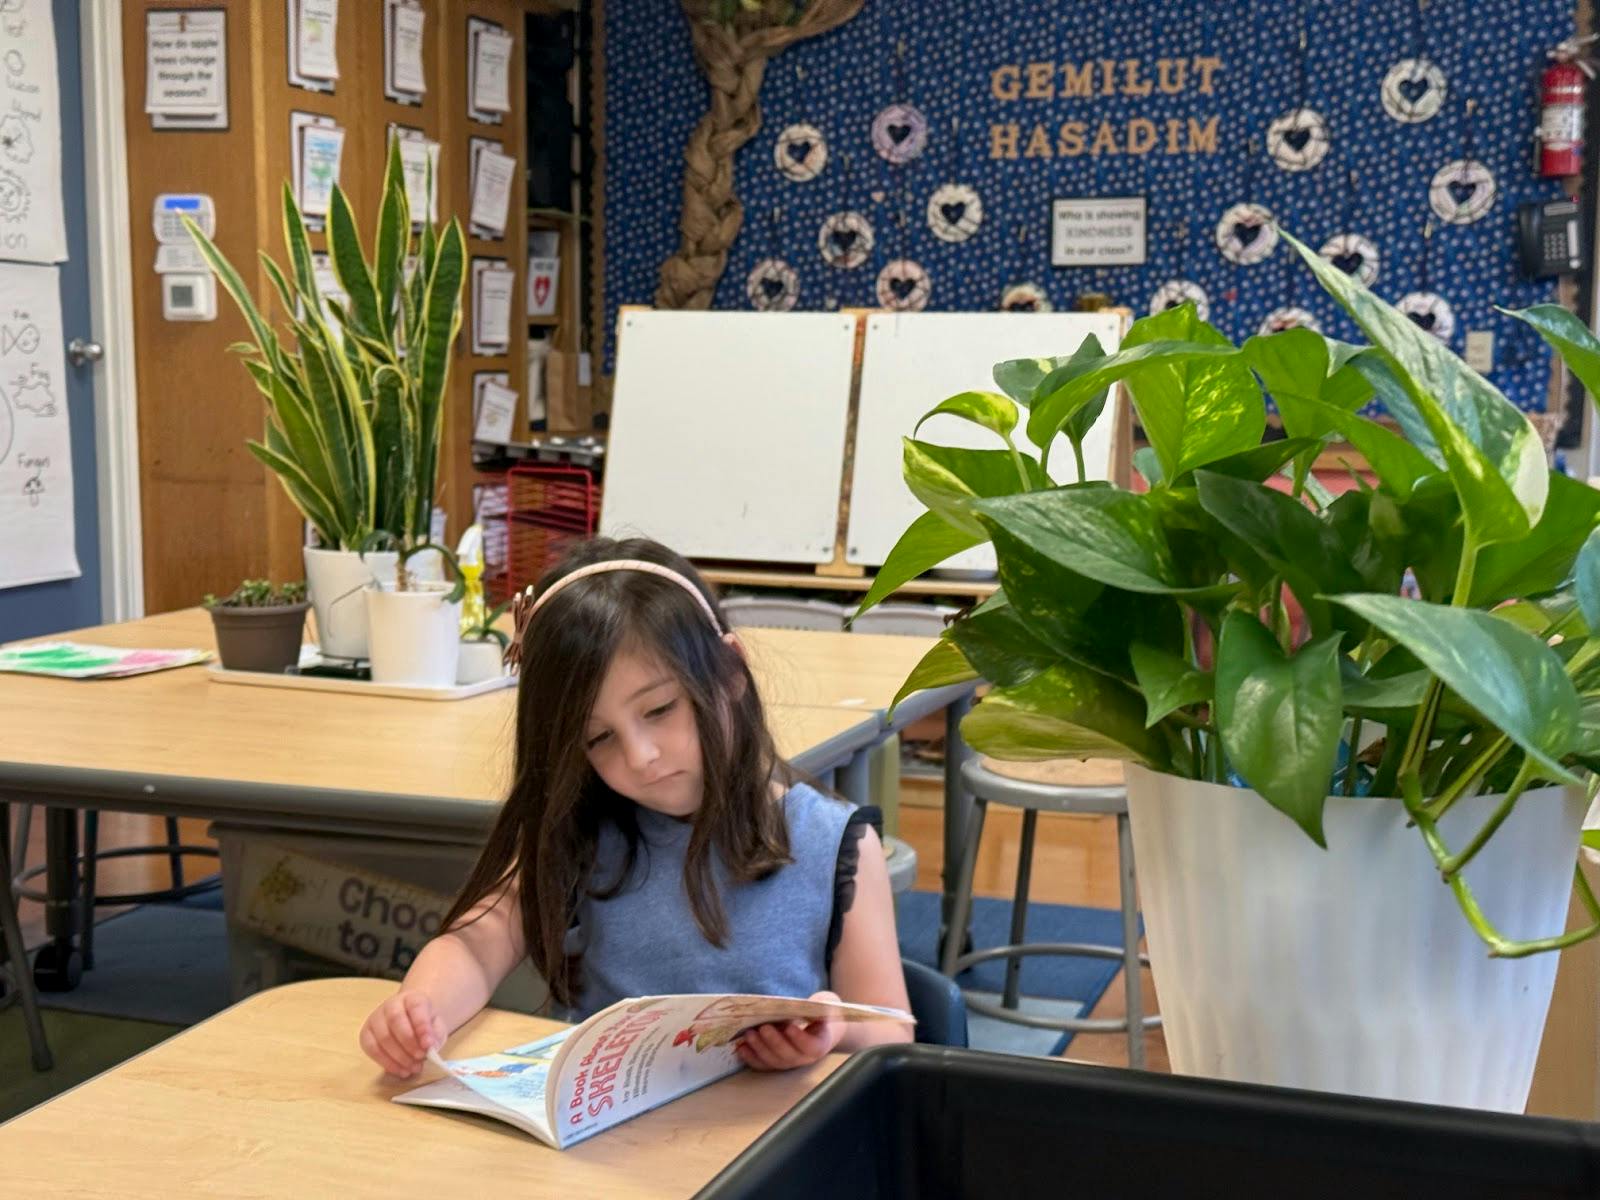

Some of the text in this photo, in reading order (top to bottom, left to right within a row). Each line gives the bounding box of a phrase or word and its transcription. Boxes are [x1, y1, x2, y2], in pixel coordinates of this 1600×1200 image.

[990, 56, 1222, 101] GEMILUT
[989, 114, 1220, 160] HASADIM
[339, 877, 444, 936] Choo
[338, 920, 379, 959] to
[390, 936, 418, 971] b
[570, 1068, 589, 1109] Book
[570, 1111, 584, 1125] A
